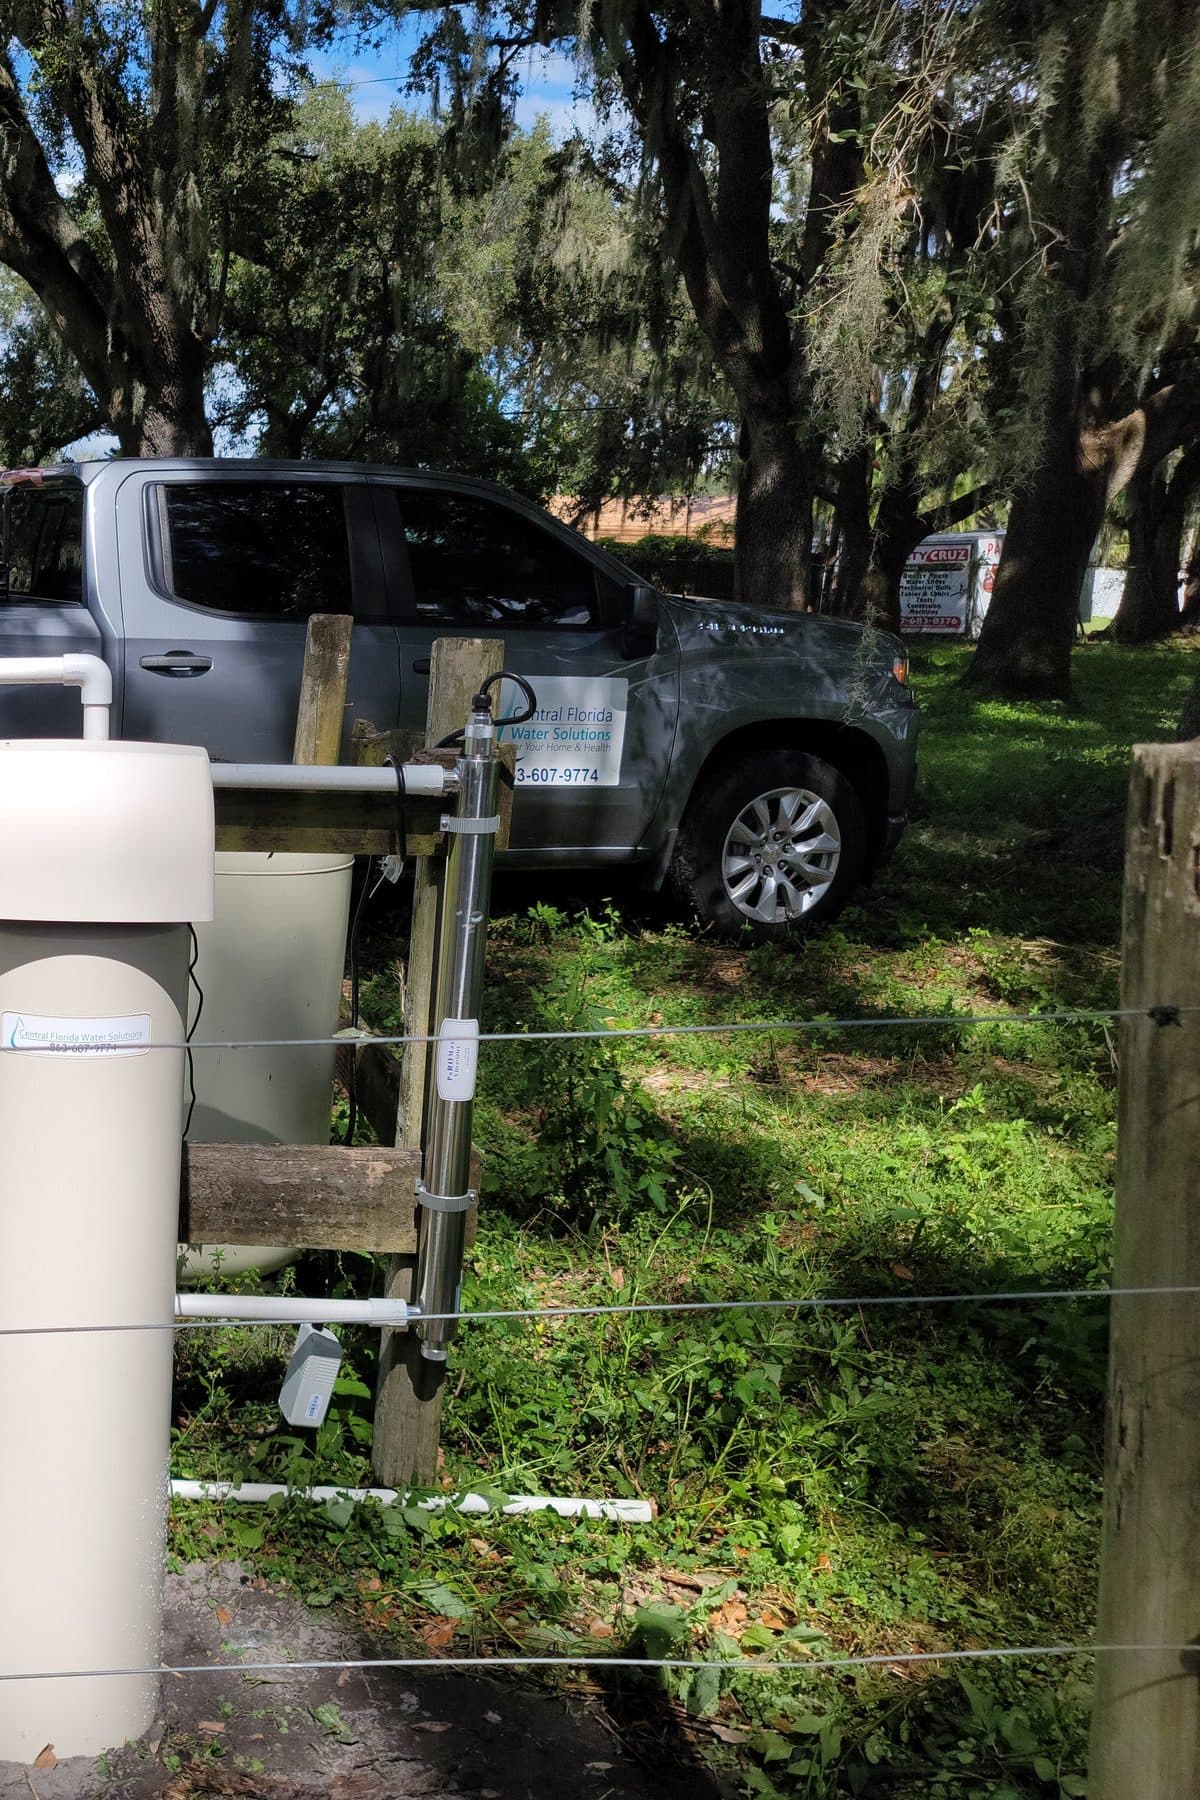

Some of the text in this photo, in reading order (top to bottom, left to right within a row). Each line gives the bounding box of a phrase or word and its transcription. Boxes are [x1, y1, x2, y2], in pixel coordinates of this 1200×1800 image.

[930, 549, 967, 561] CRUZ
[513, 706, 613, 722] Cntral Florida
[511, 726, 611, 741] Water Solutions
[524, 742, 545, 752] Your
[546, 742, 573, 752] Home
[574, 743, 581, 752] &
[583, 743, 611, 753] Health
[516, 767, 599, 782] 3-607-9774
[19, 1028, 144, 1042] Central Florida Water Solutions
